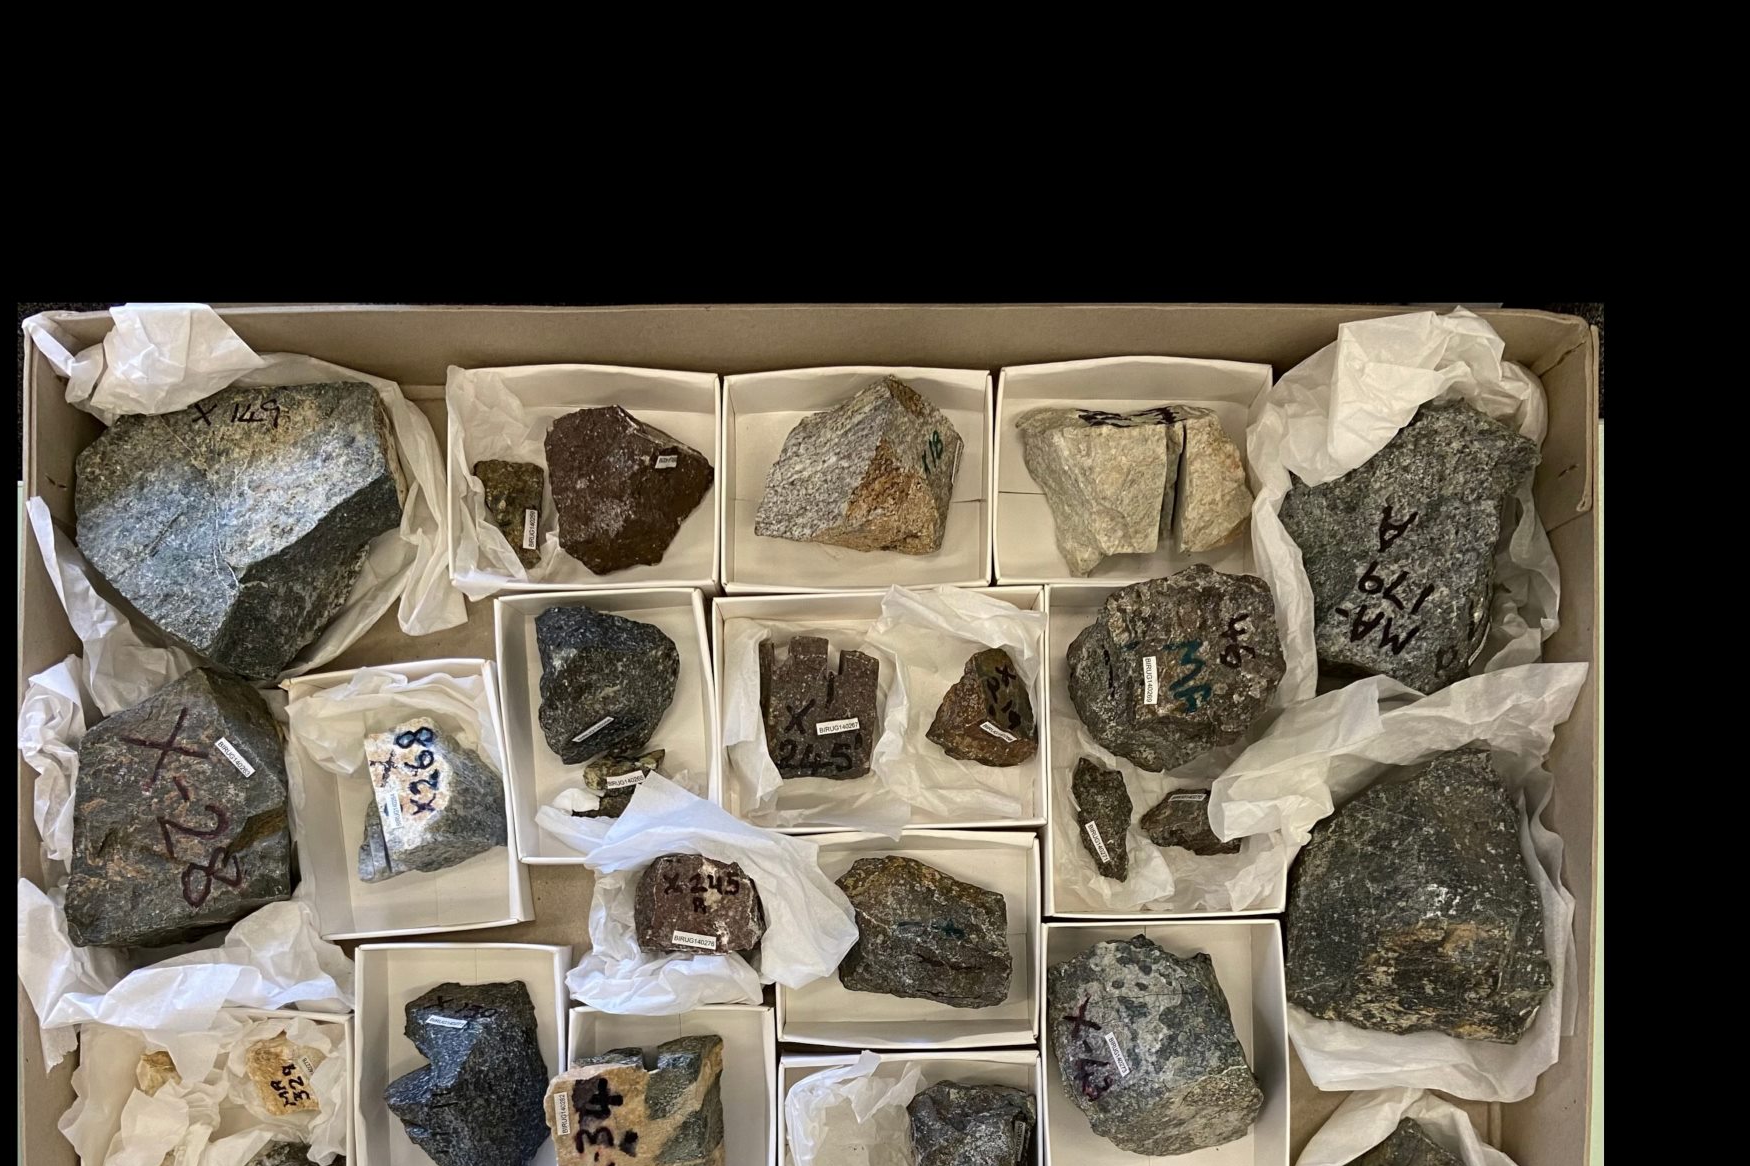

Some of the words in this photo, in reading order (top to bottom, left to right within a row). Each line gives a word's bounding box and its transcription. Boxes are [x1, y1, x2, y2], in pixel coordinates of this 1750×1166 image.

[192, 402, 217, 425] X
[1379, 505, 1418, 552] A
[1358, 560, 1435, 615] 179
[1145, 657, 1153, 703] BIRUG140269
